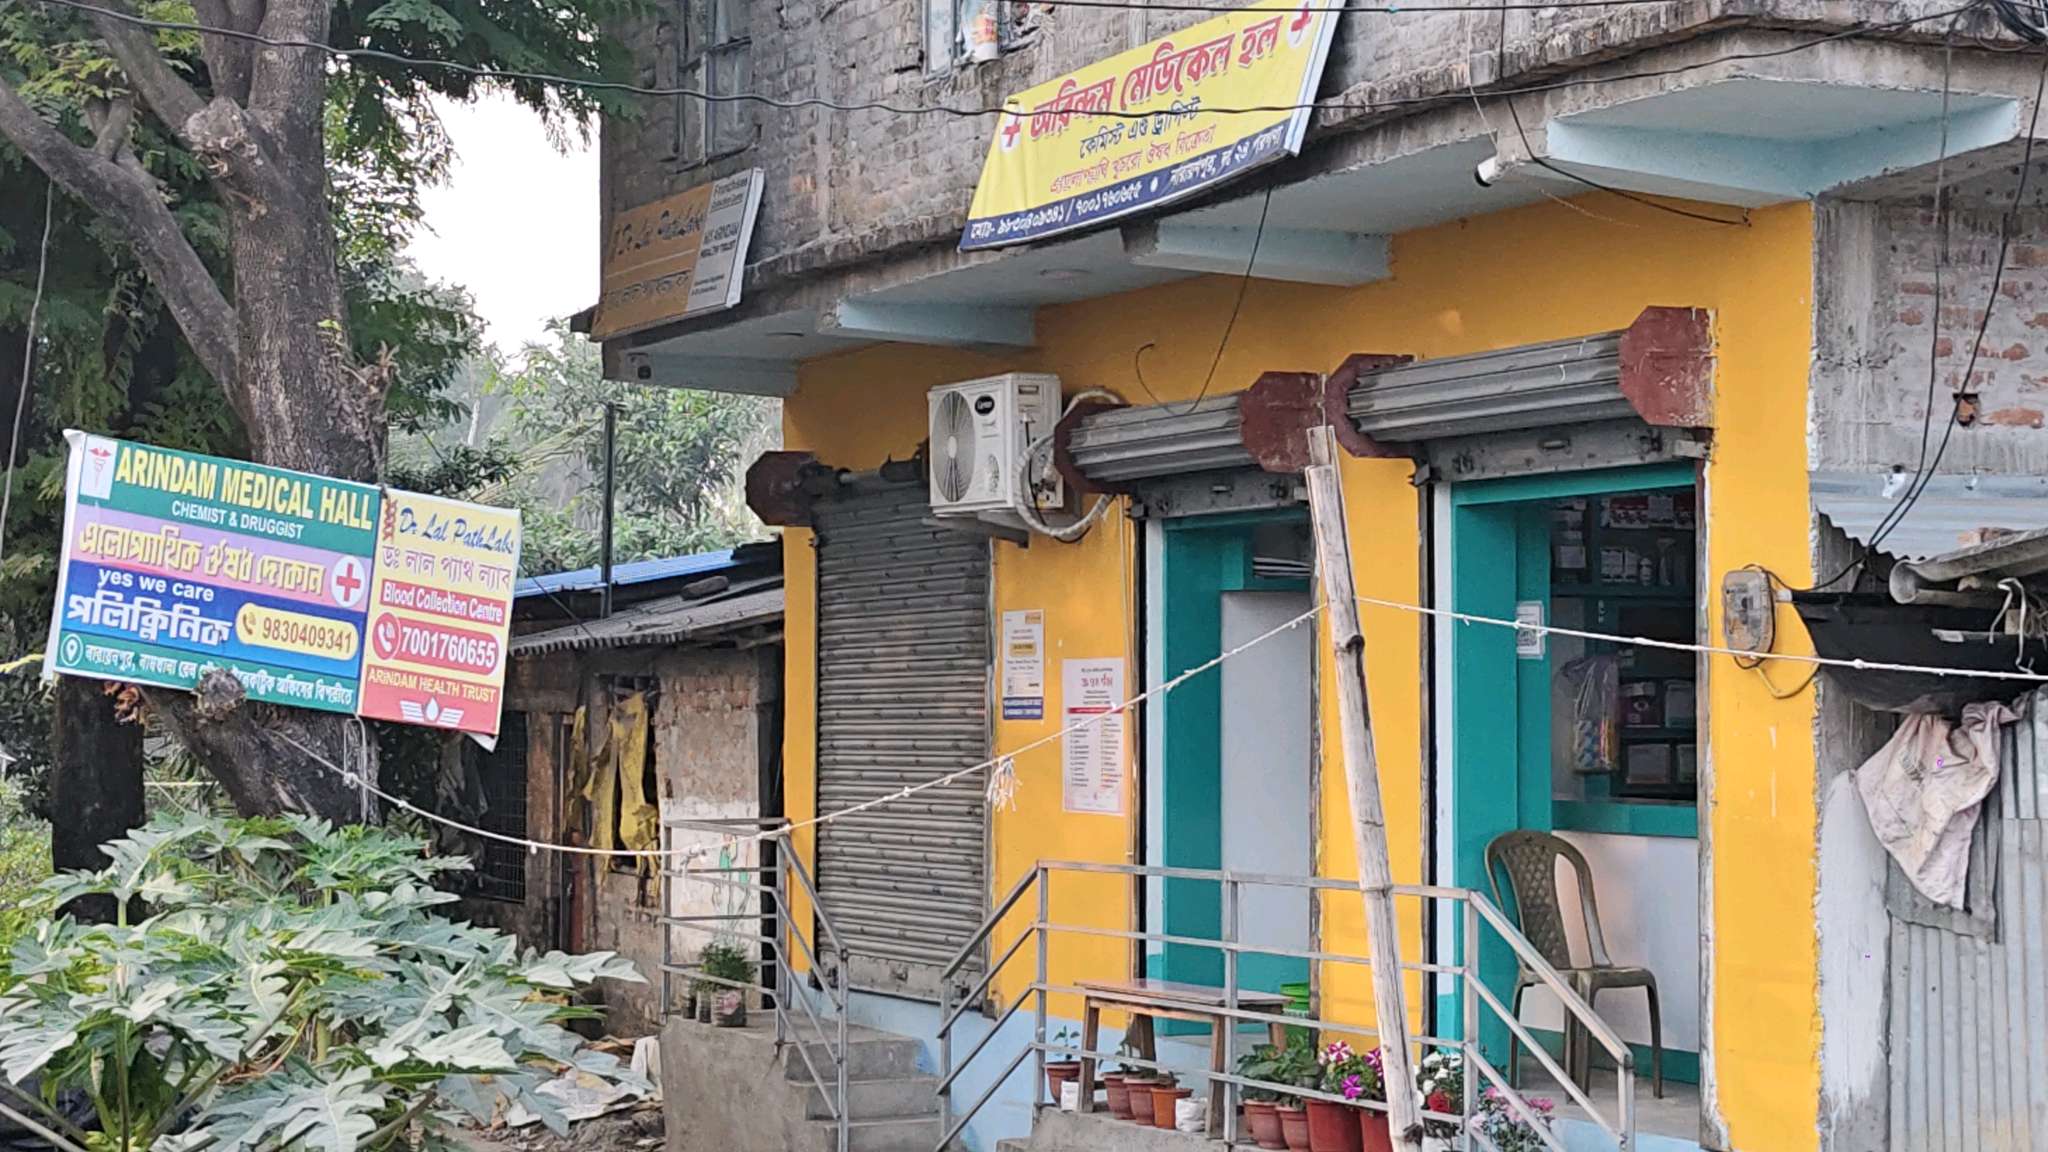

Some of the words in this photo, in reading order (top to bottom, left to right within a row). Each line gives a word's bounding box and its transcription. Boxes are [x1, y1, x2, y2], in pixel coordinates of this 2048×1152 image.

[1030, 77, 1115, 138] অরিন্দম
[1119, 41, 1235, 111] মেডিকেল
[1238, 15, 1283, 67] হল
[115, 447, 217, 500] ARINDAM
[220, 466, 314, 519] MEDICAL
[319, 485, 373, 530] HALL
[172, 500, 227, 525] CHEMIST
[229, 511, 237, 527] &
[240, 514, 303, 538] DRUGGIST
[422, 513, 449, 541] Lal
[79, 521, 203, 573] এলোপ্যাথিক
[204, 539, 253, 584] ঔষধ
[257, 554, 325, 596] দোকান
[405, 550, 435, 577] লাল
[440, 556, 474, 582] প্যাথ
[479, 564, 511, 590] ল্যাব
[98, 567, 133, 588] yes
[139, 574, 168, 592] we
[172, 581, 214, 602] care
[383, 582, 413, 607] Blood
[416, 588, 467, 615] Collection
[469, 598, 503, 622] Centre
[67, 589, 233, 647] পলিক্লিনিক
[263, 616, 352, 654] 9830409341
[401, 626, 496, 668] 7001760655
[367, 669, 416, 689] ARINDAM
[419, 675, 459, 698] HEALTH
[462, 684, 496, 703] TRUST
